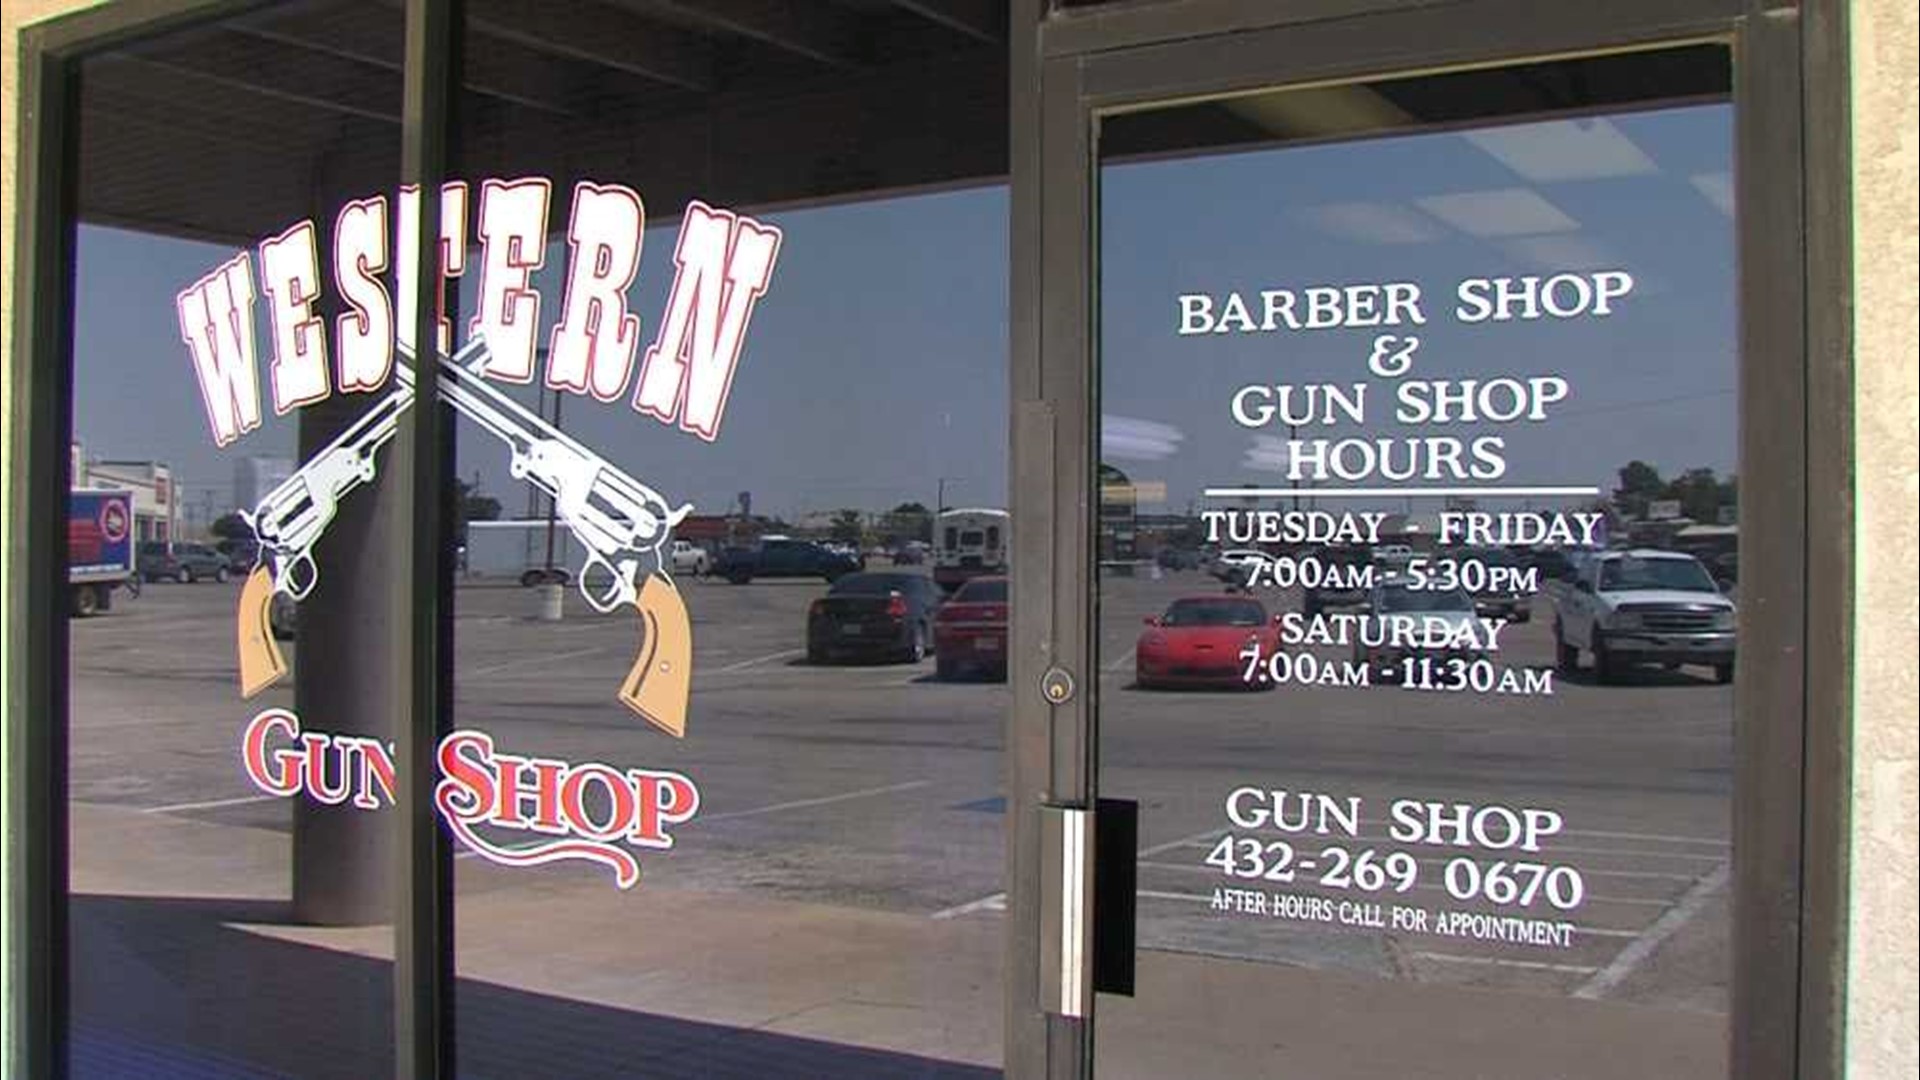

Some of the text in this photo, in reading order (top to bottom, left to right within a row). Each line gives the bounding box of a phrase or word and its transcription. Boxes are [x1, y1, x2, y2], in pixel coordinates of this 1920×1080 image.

[177, 177, 783, 447] WESTERN
[1178, 271, 1634, 335] BARBER SHOP
[1368, 335, 1419, 376] &
[1231, 376, 1569, 427] GUN SHOP
[1285, 436, 1506, 480] HOURS
[1201, 511, 1387, 545] TUESDAY
[1438, 512, 1603, 545] FRIDAY
[1246, 556, 1374, 588] 7:00AM
[1406, 558, 1538, 592] 5:30PM
[1280, 612, 1507, 650] SATURDAY
[1239, 645, 1370, 687] 7:00AM
[244, 708, 700, 889] GUN SHOP
[1225, 787, 1562, 851] GUN SHOP
[1206, 836, 1584, 909] 432-269 0670
[1211, 888, 1575, 946] AFTER HOURS CALL FOR APPOINTMENT
